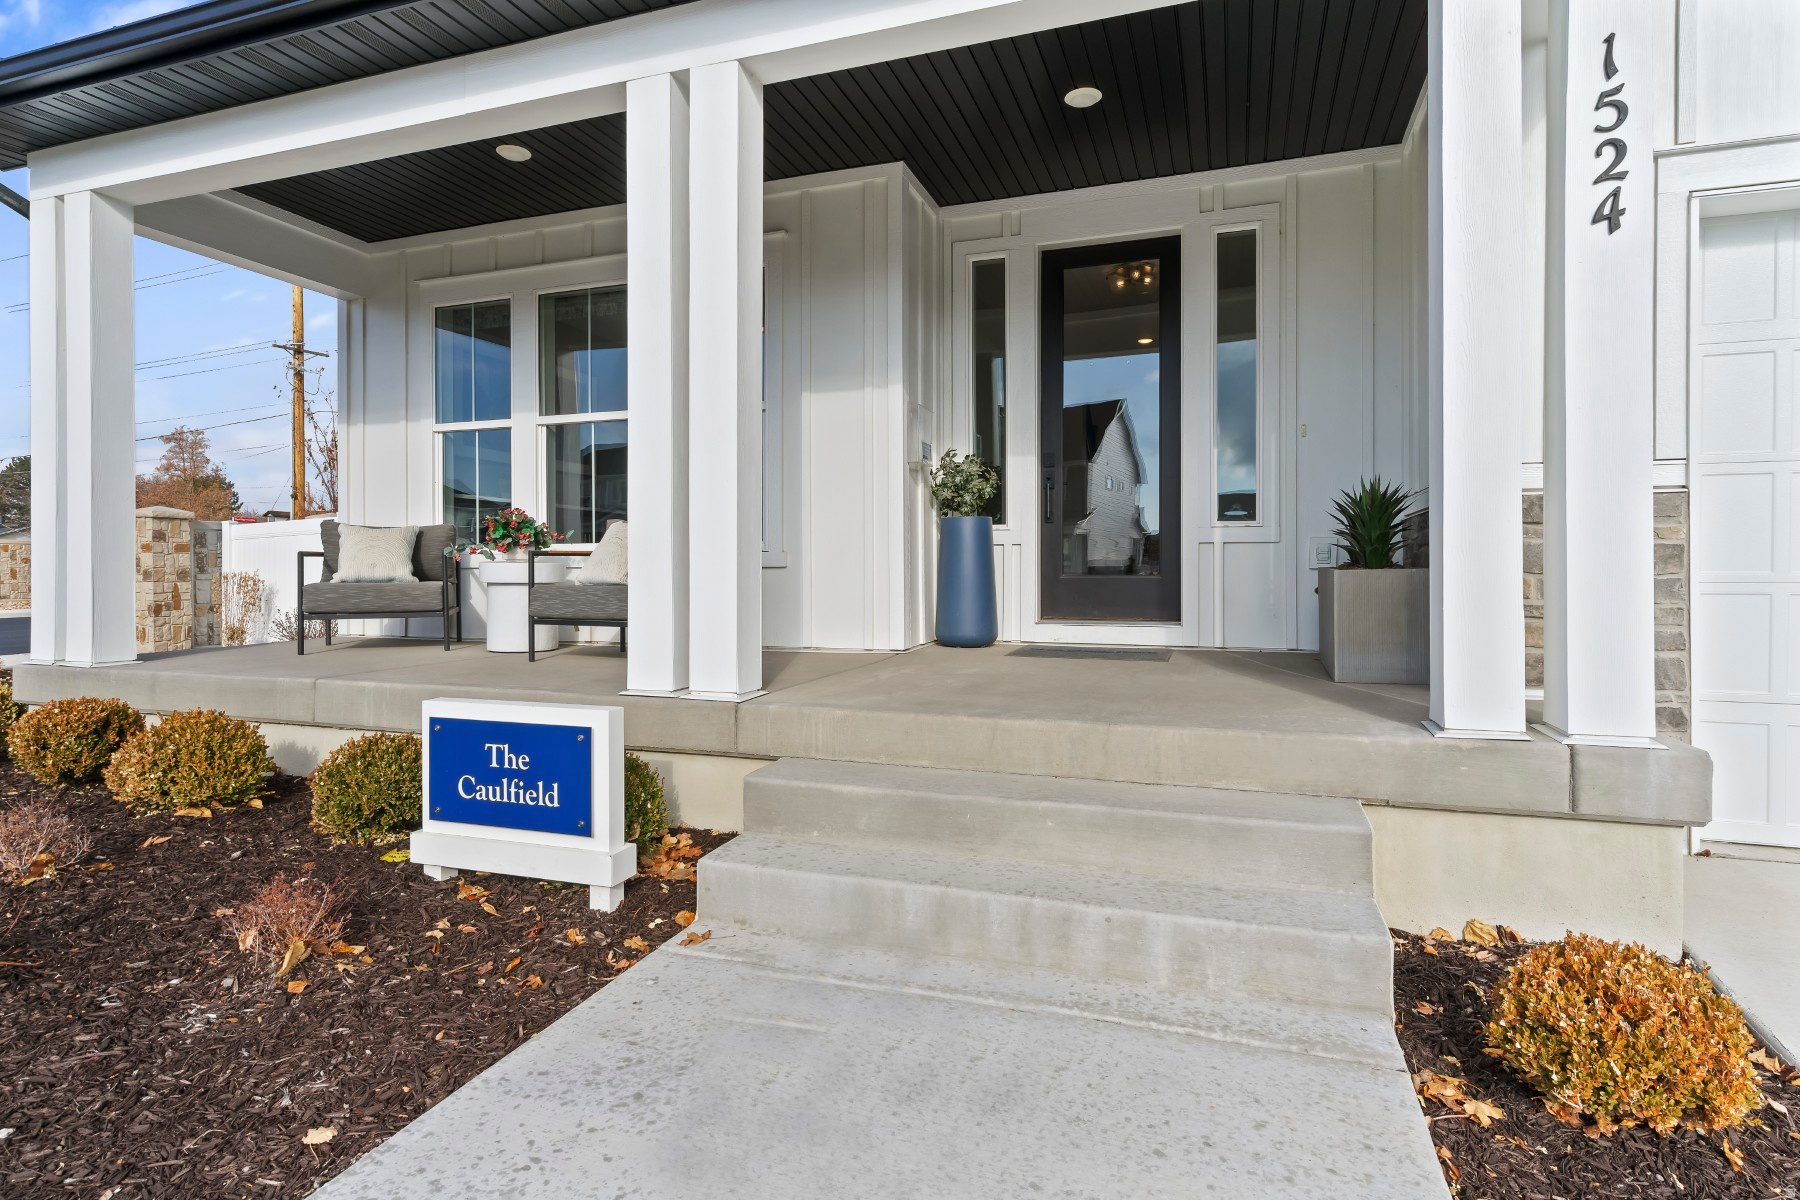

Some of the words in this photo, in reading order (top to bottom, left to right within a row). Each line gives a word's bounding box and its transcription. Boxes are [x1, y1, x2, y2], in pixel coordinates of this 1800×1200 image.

[1591, 32, 1630, 235] 1524
[485, 743, 530, 770] The
[457, 774, 560, 808] Caulfield
